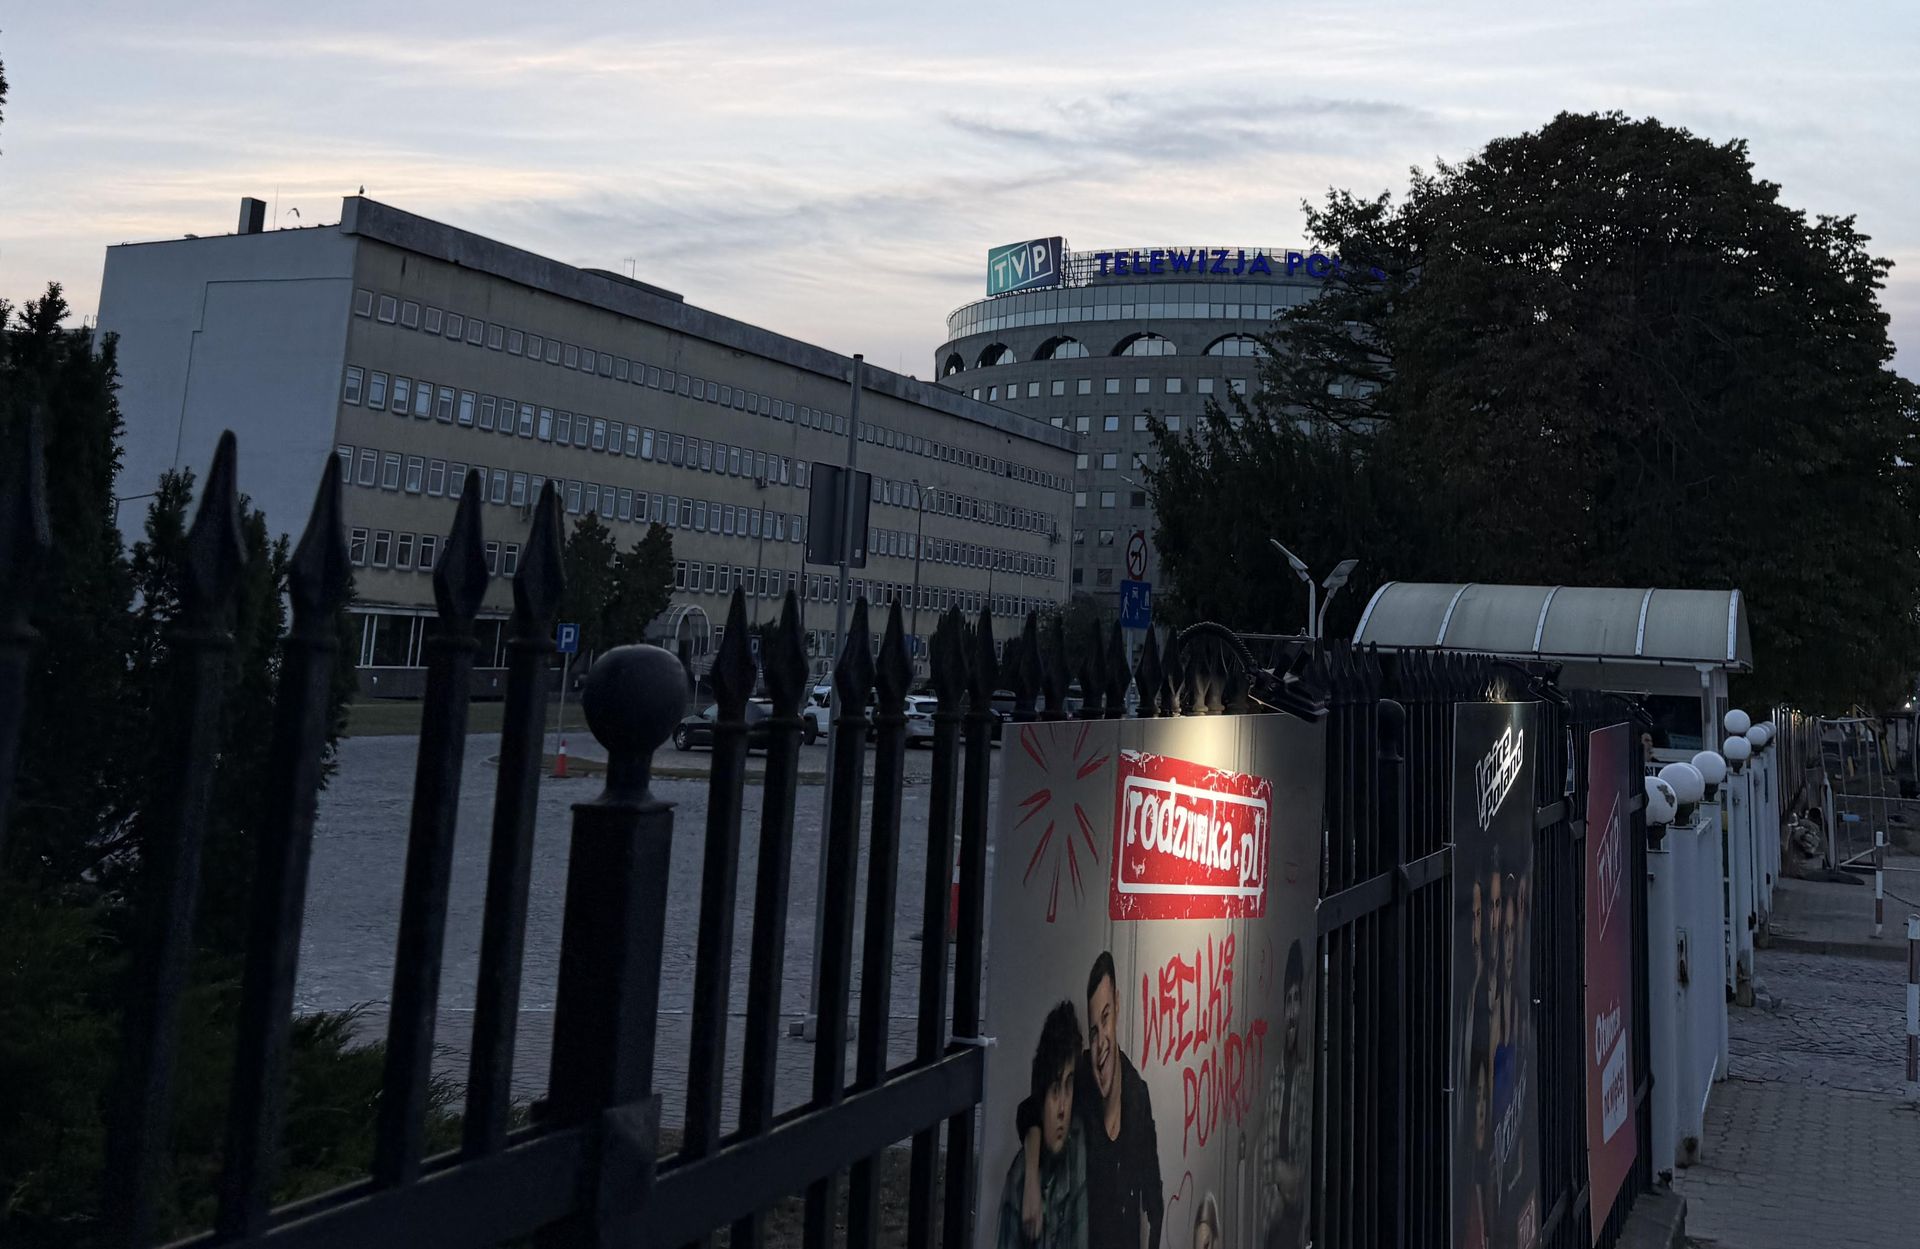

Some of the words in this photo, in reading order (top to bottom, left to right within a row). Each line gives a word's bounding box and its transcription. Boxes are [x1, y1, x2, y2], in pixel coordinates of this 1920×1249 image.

[994, 245, 1046, 288] TVP
[1095, 247, 1271, 277] TELEWIZJA
[561, 626, 575, 649] P
[1126, 777, 1262, 899] rodzinka.pl
[1142, 933, 1236, 1071] WIELKI
